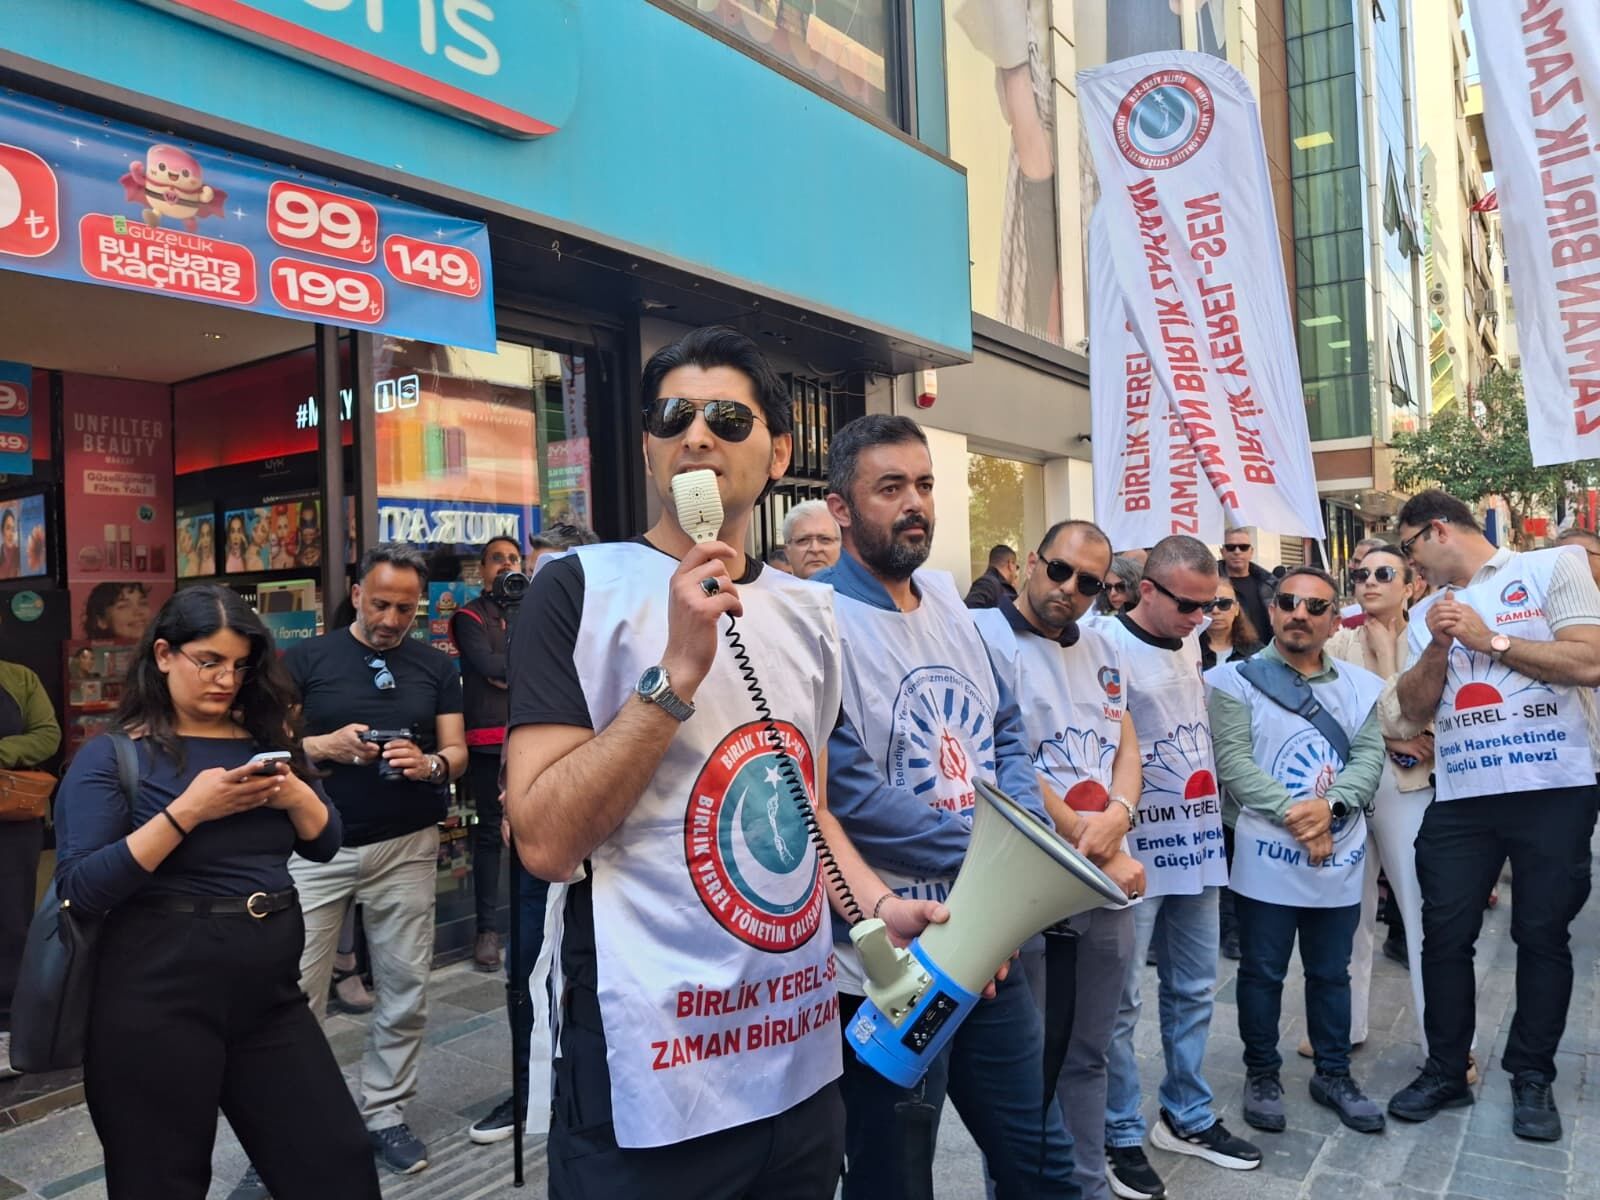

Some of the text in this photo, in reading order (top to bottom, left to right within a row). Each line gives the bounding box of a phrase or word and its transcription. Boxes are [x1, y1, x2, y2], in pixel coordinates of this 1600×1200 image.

[73, 413, 163, 440] UNFILTER
[82, 433, 155, 457] BEAUTY
[1118, 431, 1151, 513] BİRLİK
[1455, 708, 1507, 729] YEREL
[1524, 703, 1558, 719] SEN
[720, 732, 755, 771] BİRLİK
[1464, 729, 1567, 752] Hareketinde
[1481, 750, 1503, 769] Bir
[1509, 747, 1558, 765] Mevzi
[693, 794, 714, 857] BİRLİK
[1138, 804, 1176, 825] TÜM
[1136, 834, 1187, 851] Emek
[1256, 839, 1300, 866] TÜM
[698, 859, 733, 913] YEREL
[730, 904, 787, 943] YÖNETİM
[676, 980, 761, 1018] BİRLİK
[651, 1028, 741, 1071] ZAMAN
[747, 1007, 811, 1051] BİRLİK
